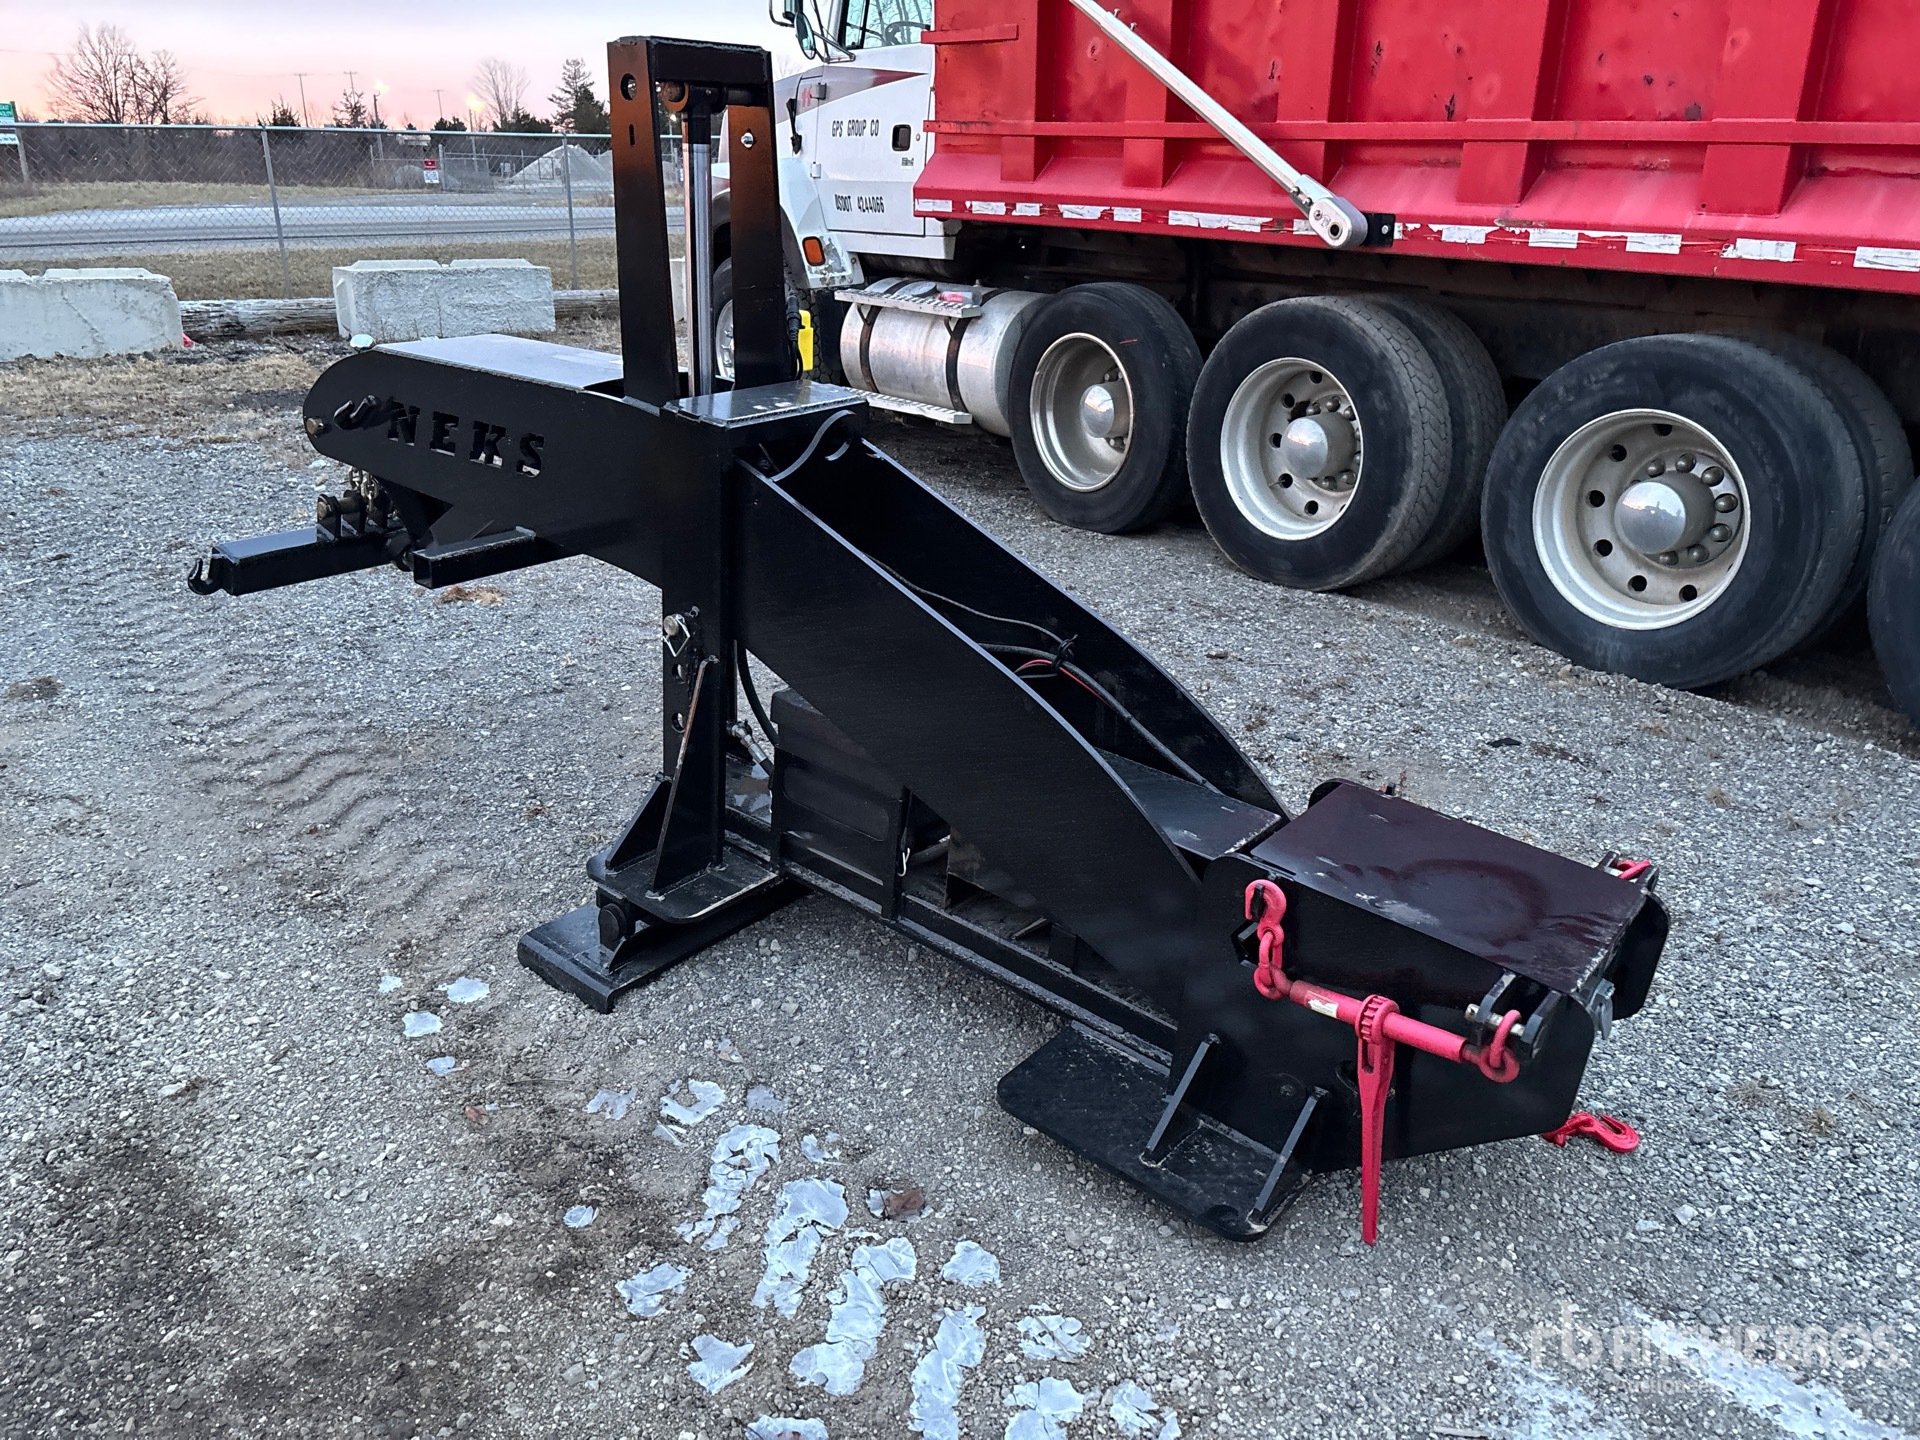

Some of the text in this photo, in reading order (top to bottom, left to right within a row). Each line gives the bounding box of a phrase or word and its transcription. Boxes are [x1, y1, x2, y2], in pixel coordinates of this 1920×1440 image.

[832, 119, 879, 137] GPS GROUP CO
[834, 194, 852, 212] USDOT
[387, 400, 545, 478] NEKS
